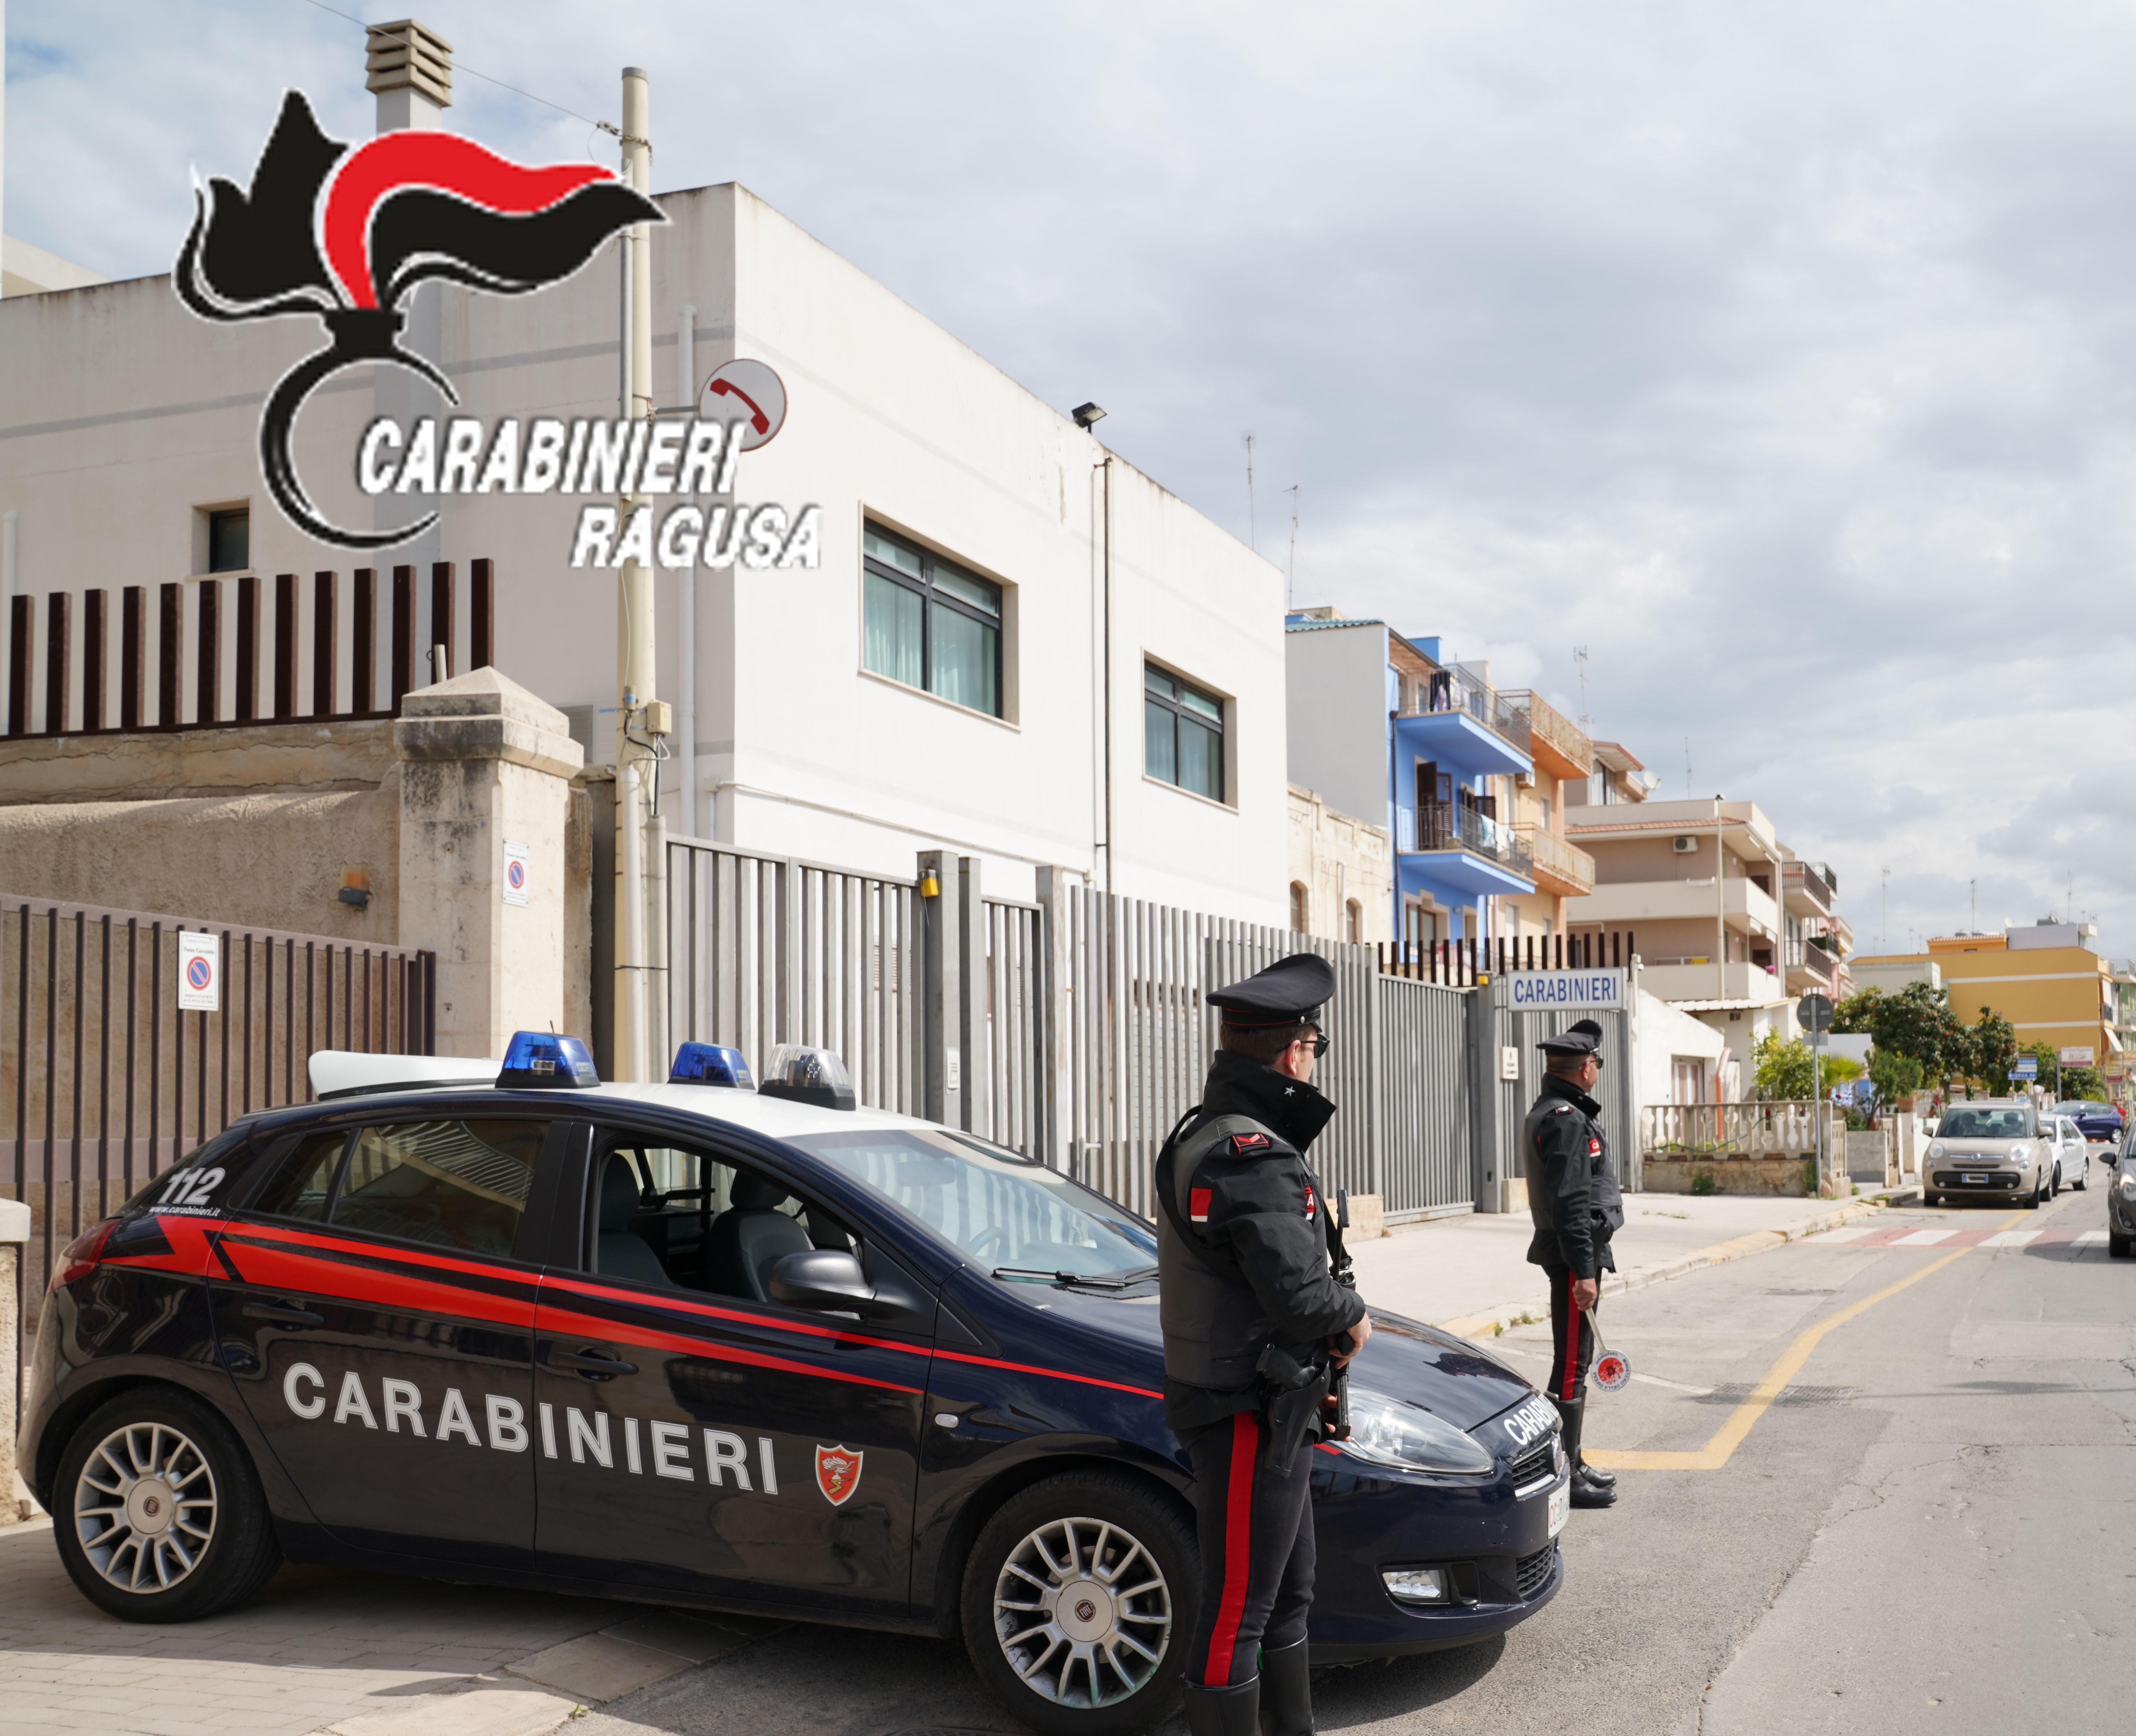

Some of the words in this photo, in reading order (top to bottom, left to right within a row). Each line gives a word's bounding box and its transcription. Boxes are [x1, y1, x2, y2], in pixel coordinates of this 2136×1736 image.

[1515, 977, 1616, 1003] CARABINIERI
[157, 1167, 225, 1205] 112
[149, 1206, 221, 1216] www.carabinieri.it
[283, 1362, 778, 1495] CARABINIERI
[1079, 1604, 1092, 1618] FIAT
